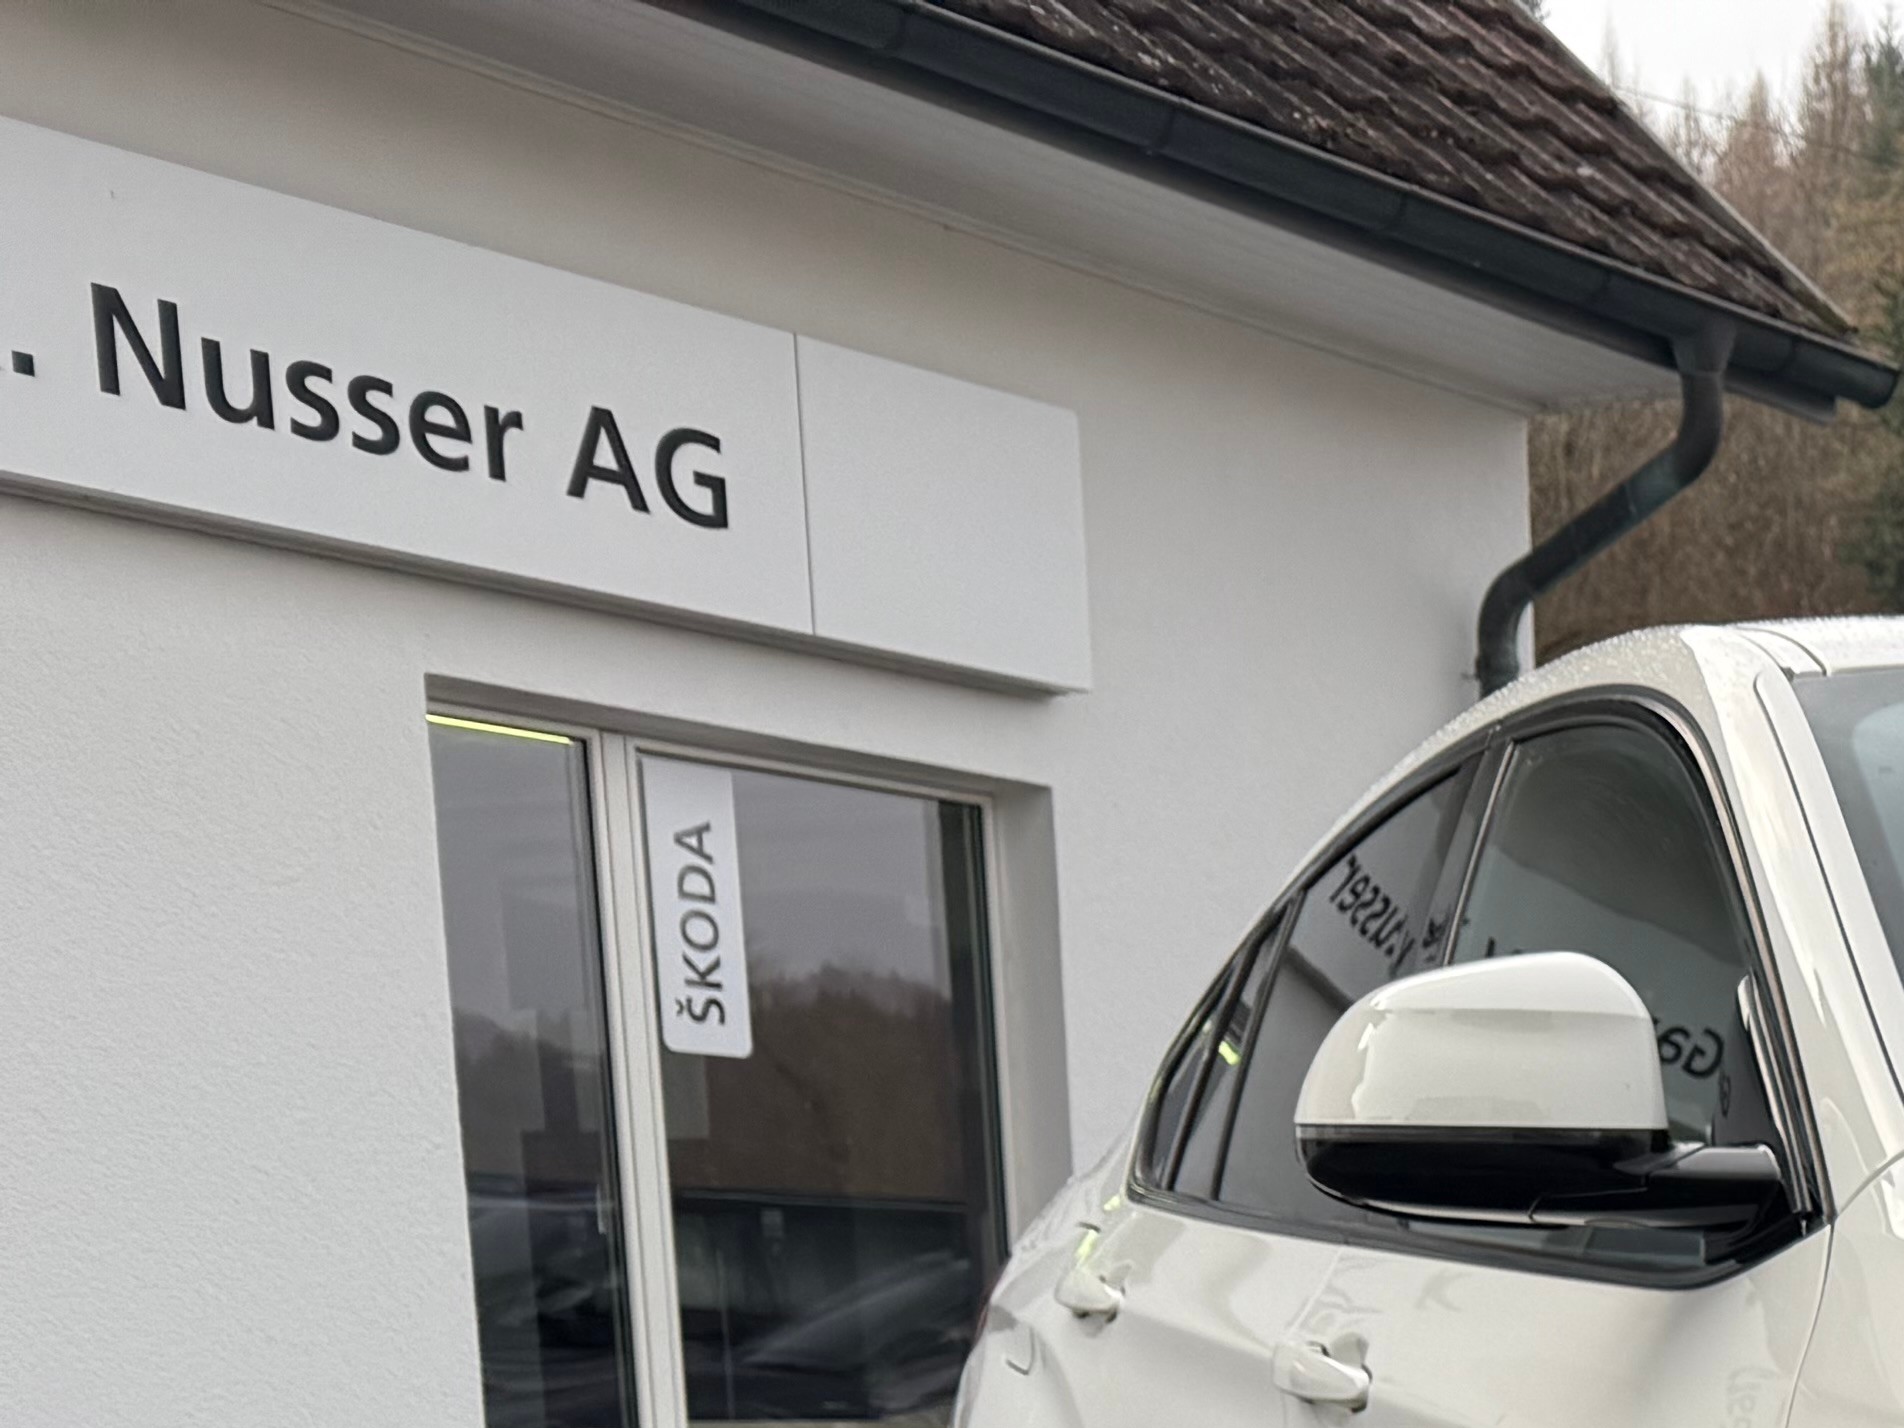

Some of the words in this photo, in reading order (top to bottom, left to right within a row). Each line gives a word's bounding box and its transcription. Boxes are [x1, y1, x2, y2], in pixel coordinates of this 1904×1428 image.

[90, 282, 524, 481] Nusser
[566, 405, 729, 529] AG
[673, 821, 726, 1026] ŠKODA
